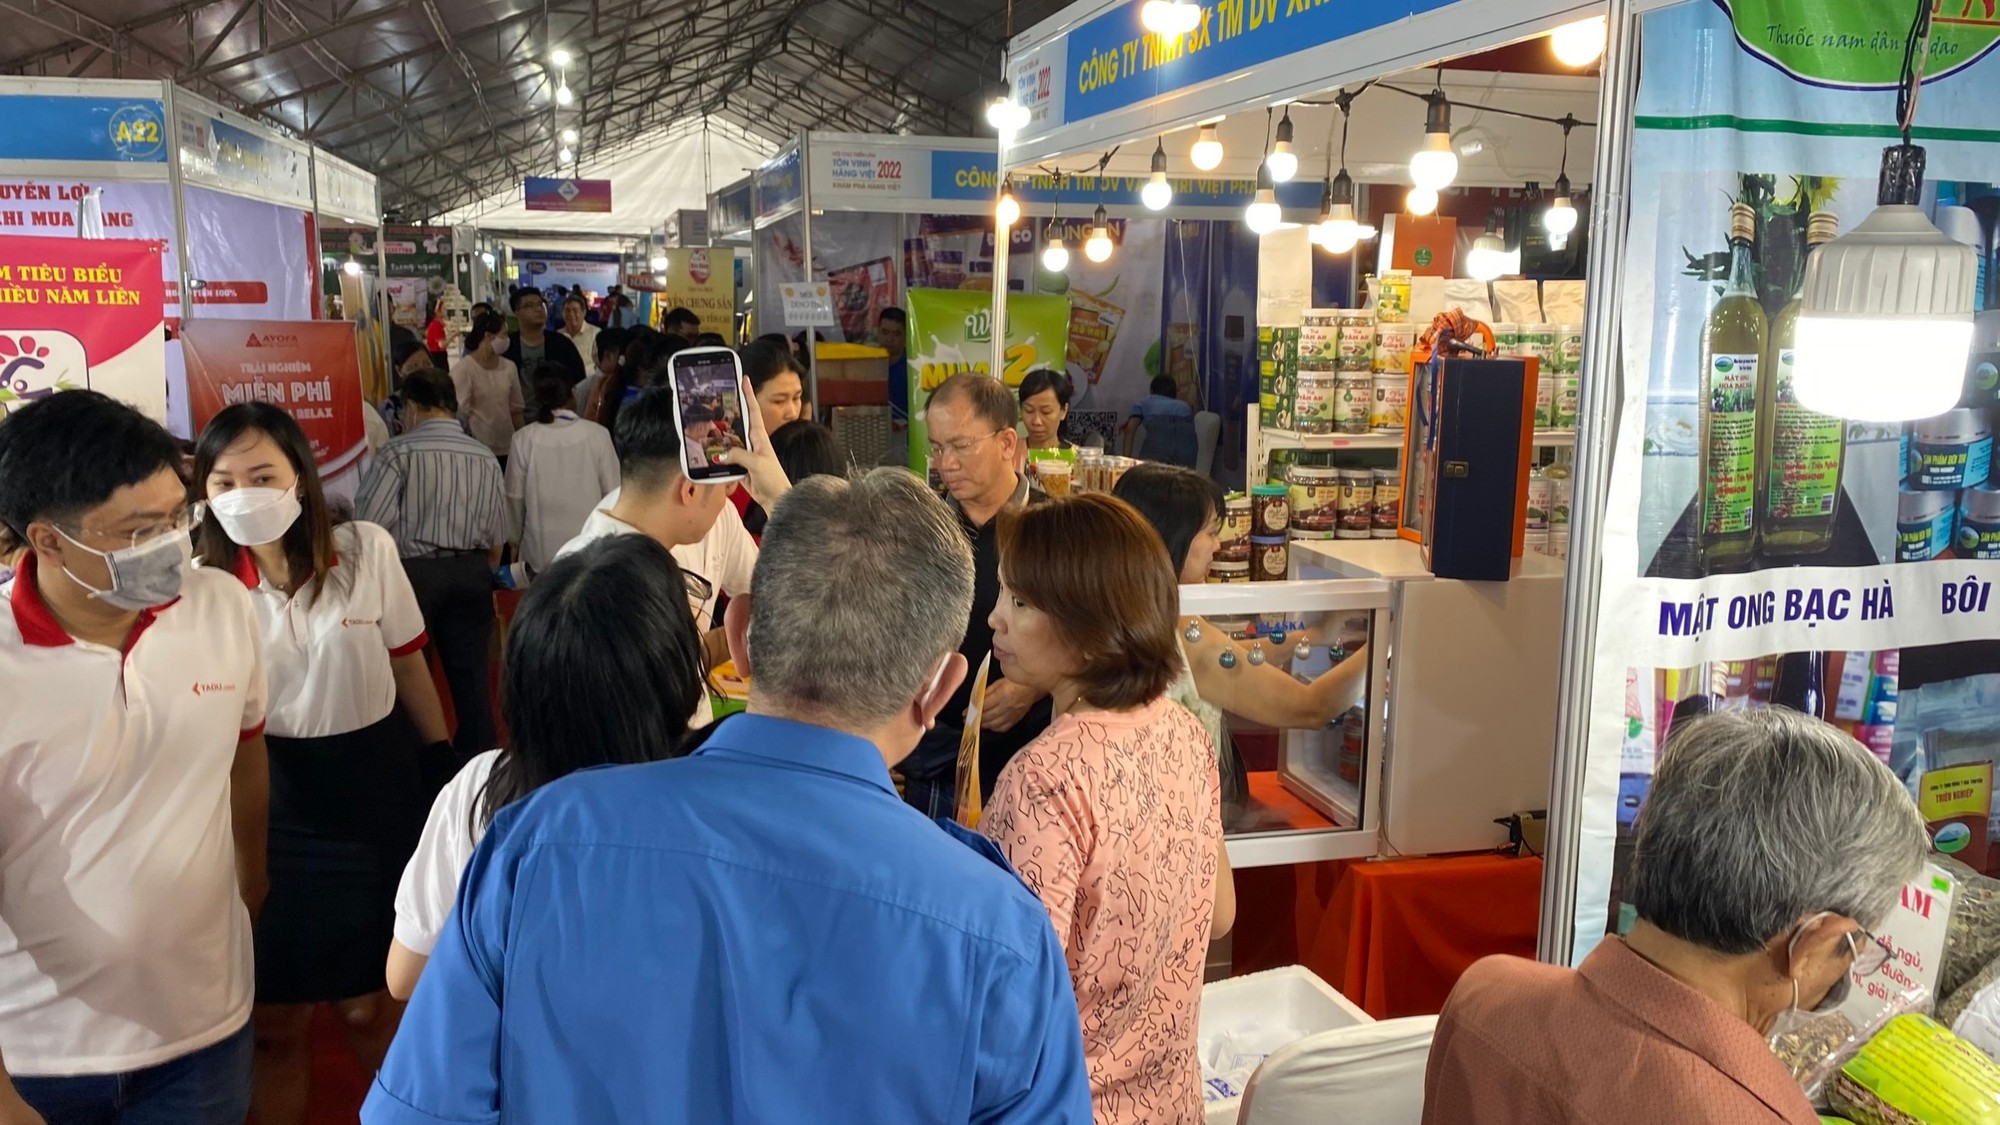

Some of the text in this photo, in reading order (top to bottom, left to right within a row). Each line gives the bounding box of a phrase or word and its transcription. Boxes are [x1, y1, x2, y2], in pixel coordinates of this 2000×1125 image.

[1079, 48, 1119, 94] CÔNG
[1123, 39, 1140, 78] TY
[1218, 0, 1243, 42] TM
[1766, 23, 1815, 47] Thuốc
[1820, 34, 1867, 49] nam
[1870, 31, 1900, 56] dân
[1037, 65, 1051, 100] 2022
[832, 158, 902, 179] TÔN VINH 2022
[832, 168, 876, 179] HÀNG VIỆT
[31, 211, 75, 226] MUA
[17, 262, 67, 283] TIÊU
[73, 262, 122, 284] BIỂU
[46, 286, 91, 305] NĂM
[96, 285, 141, 306] LIỀN
[215, 288, 238, 298] 100%
[1003, 343, 1037, 388] 2
[221, 374, 332, 405] MIỄN PHÍ
[296, 408, 334, 420] RELAX
[1941, 575, 1992, 616] BÔI
[1658, 579, 1894, 642] MẬT ONG BẠC HÀ
[1896, 946, 1924, 972] ngủ,
[1866, 980, 1889, 1001] giải
